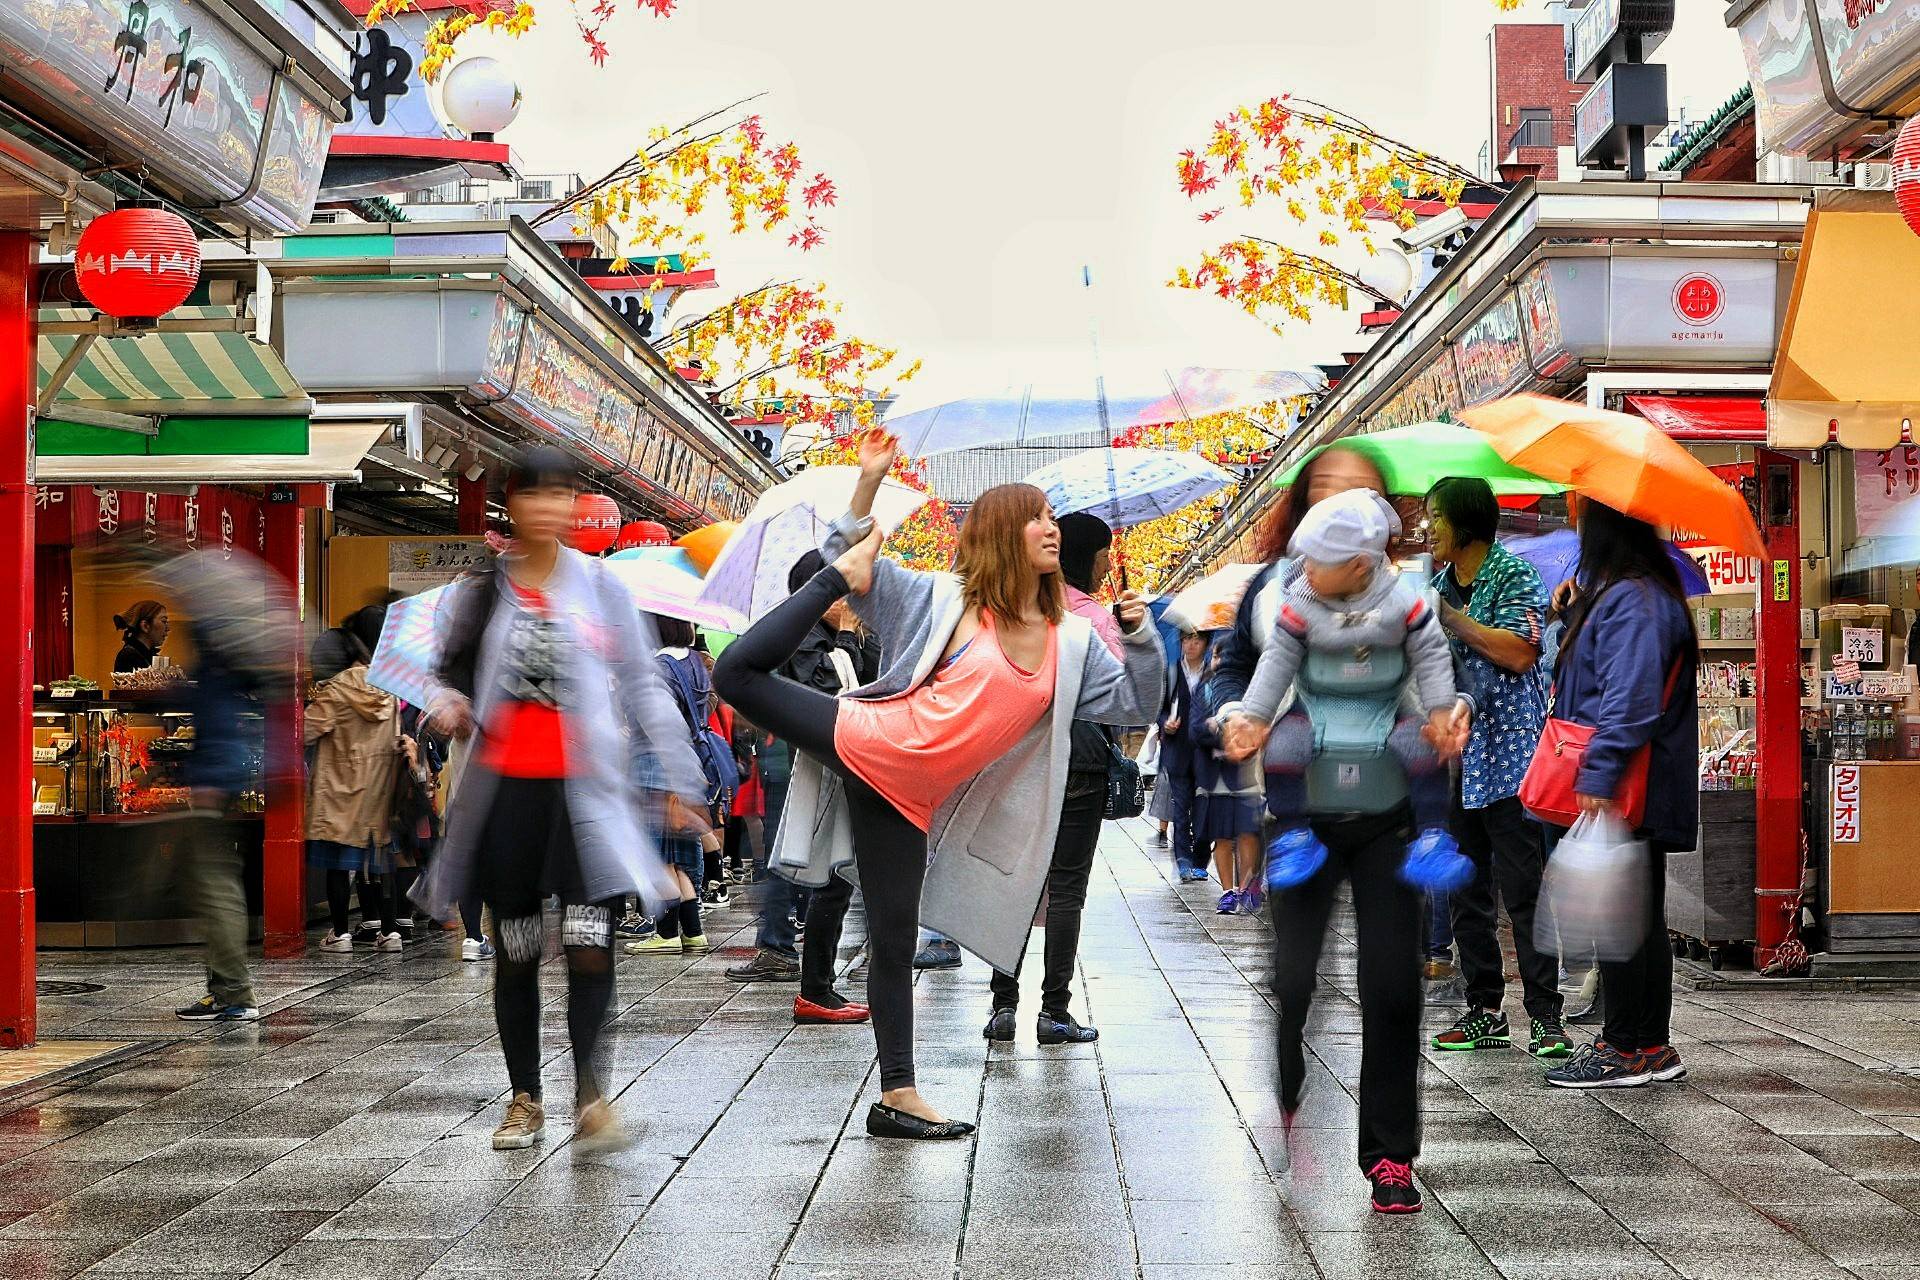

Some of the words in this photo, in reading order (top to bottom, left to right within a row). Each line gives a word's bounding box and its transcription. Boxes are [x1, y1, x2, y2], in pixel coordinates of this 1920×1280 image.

[1671, 331, 1723, 340] agemanju
[271, 492, 293, 501] 30-1
[1848, 649, 1874, 661] ¥50
[1836, 768, 1859, 840] タピオカ
